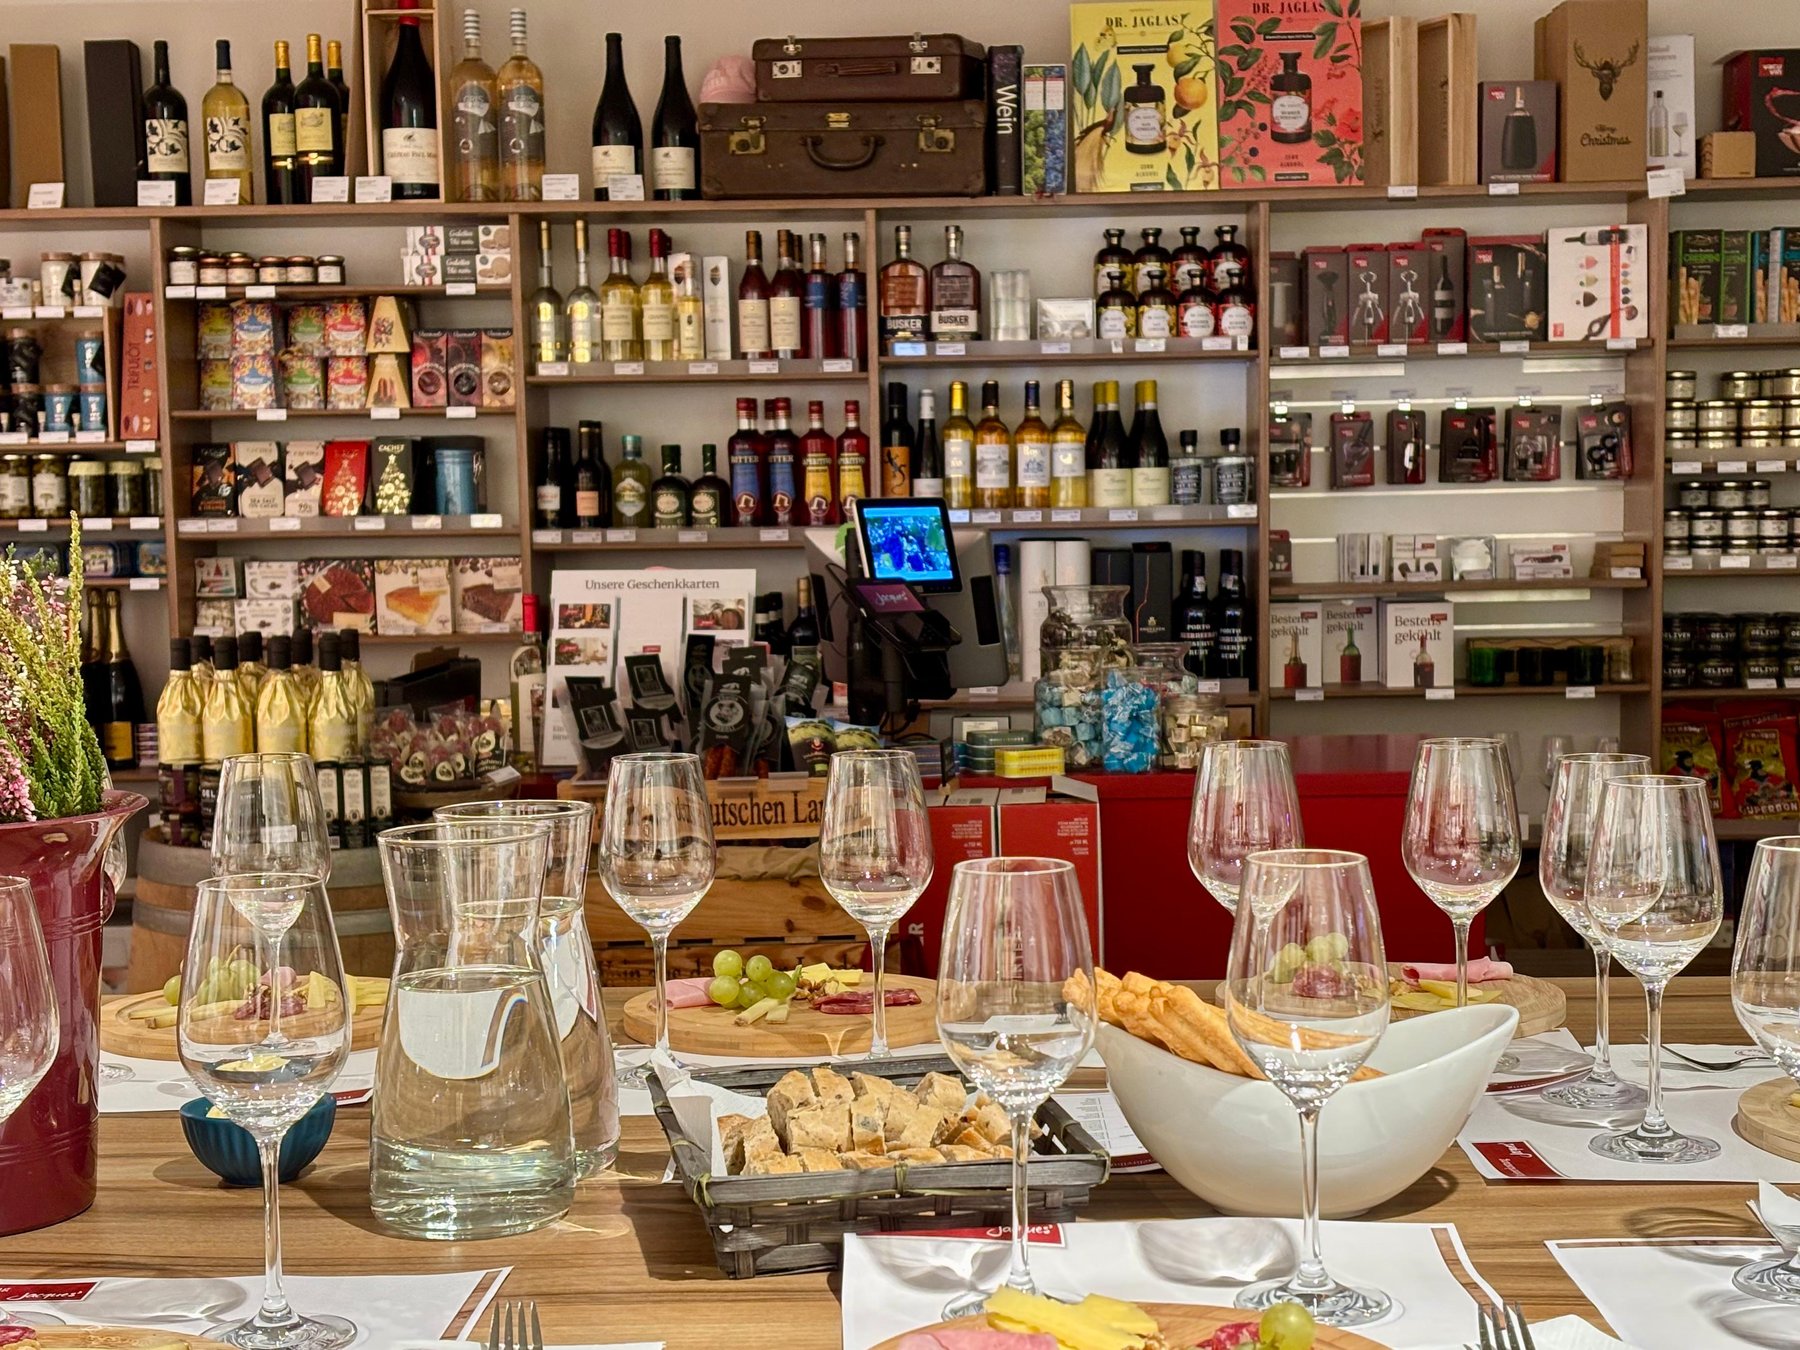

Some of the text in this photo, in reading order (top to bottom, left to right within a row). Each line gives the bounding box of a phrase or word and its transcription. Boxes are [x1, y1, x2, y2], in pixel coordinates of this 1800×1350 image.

[1252, 0, 1326, 14] DR. JAGLAS
[1106, 17, 1128, 28] DR.
[996, 84, 1017, 135] Wein
[1580, 132, 1631, 147] Christmas
[887, 319, 922, 330] BUSKER
[938, 314, 969, 324] BUSKER
[731, 455, 759, 463] BITTER
[585, 578, 720, 591] Unsere Geschenkkarten
[1270, 613, 1309, 625] Bestens
[1327, 609, 1364, 621] Bestens
[1394, 615, 1441, 627] Bestens
[1394, 629, 1441, 645] gekühlt
[711, 793, 788, 826] utschen
[986, 1223, 1054, 1238] Jaues'
